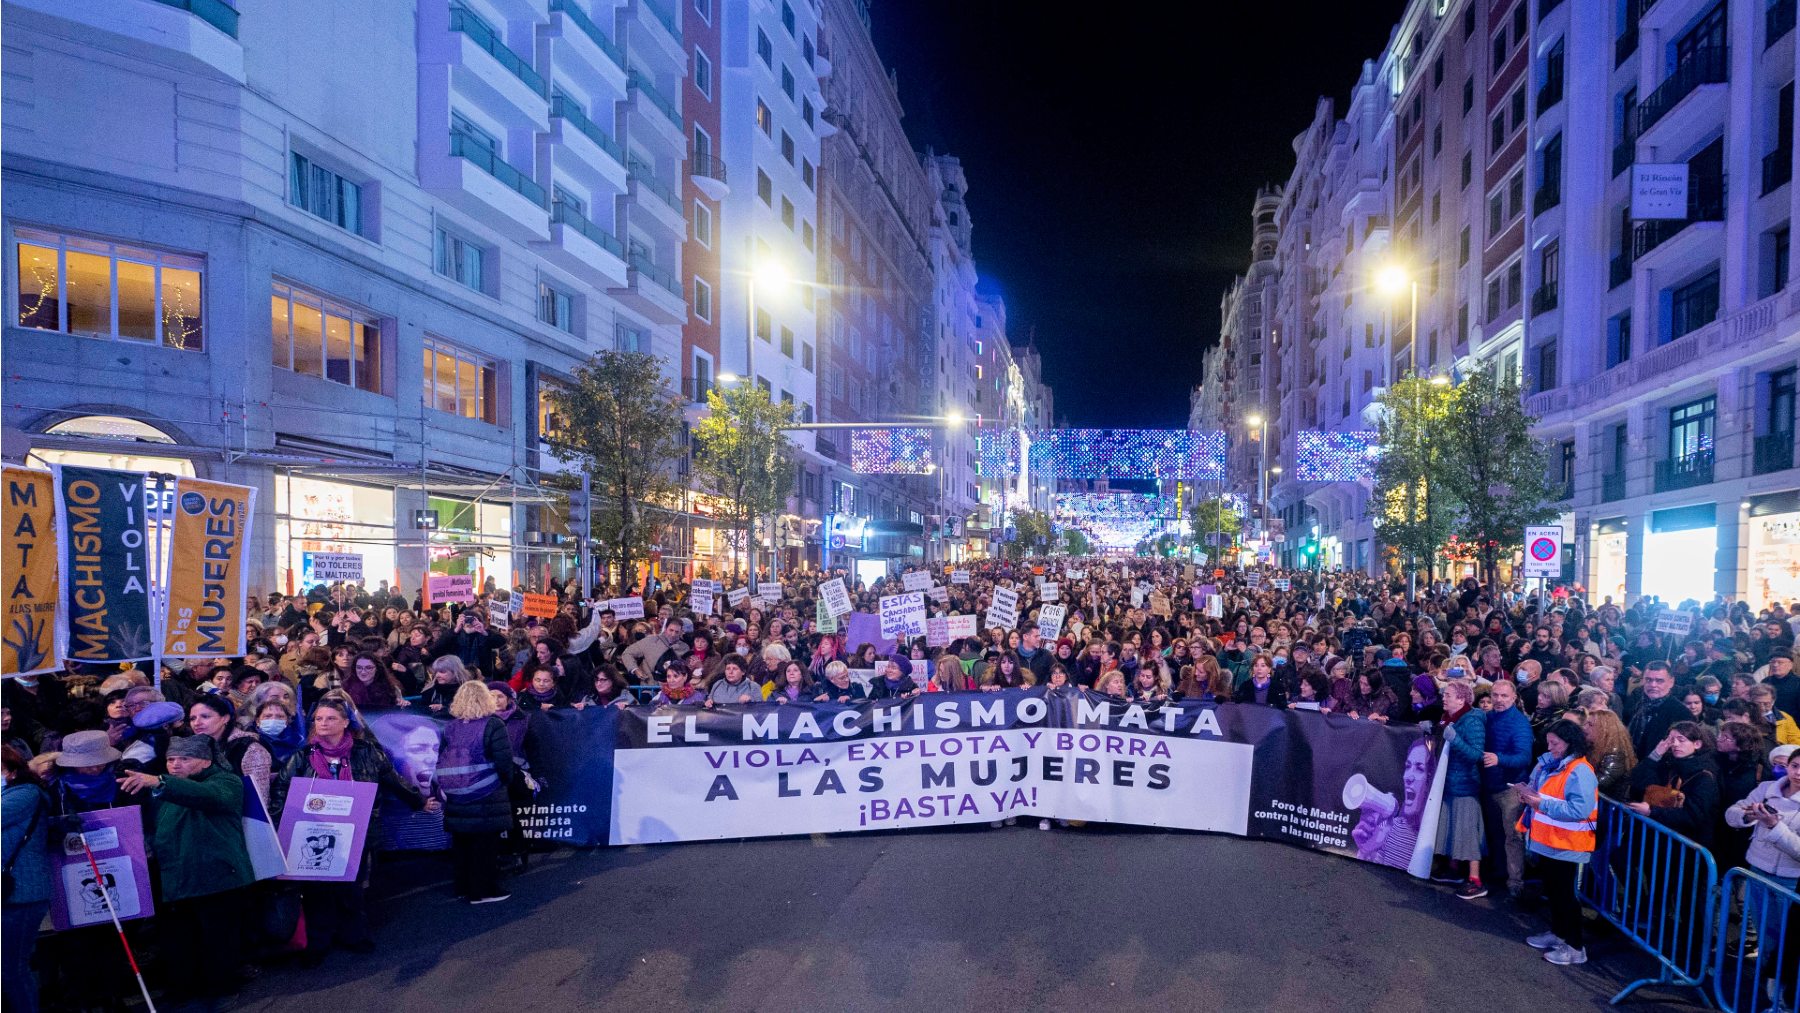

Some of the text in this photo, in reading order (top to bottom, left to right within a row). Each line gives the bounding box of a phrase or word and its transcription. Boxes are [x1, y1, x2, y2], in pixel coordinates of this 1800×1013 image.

[10, 481, 38, 599] MATA
[118, 482, 145, 595] VIOLA
[67, 479, 110, 659] MACHISMO
[197, 497, 236, 654] MUJERES
[315, 561, 363, 570] NO TOLERES
[315, 570, 324, 579] EL
[172, 606, 194, 637] las
[883, 606, 917, 618] CANSADO
[646, 697, 1224, 744] EL MACHISMO MATA
[704, 731, 1172, 769] VIOLA, EXPLOTA Y BORRA
[704, 755, 1172, 803] A LAS MUJERES
[516, 803, 587, 816] ovimiento
[859, 786, 1038, 827] ¡BASTA YA!
[1271, 799, 1351, 824] Foro de Madrid
[518, 815, 572, 828] minista
[522, 827, 574, 839] Madrid
[1254, 810, 1349, 836] contra la violencia
[1281, 824, 1347, 848] a las mujeres
